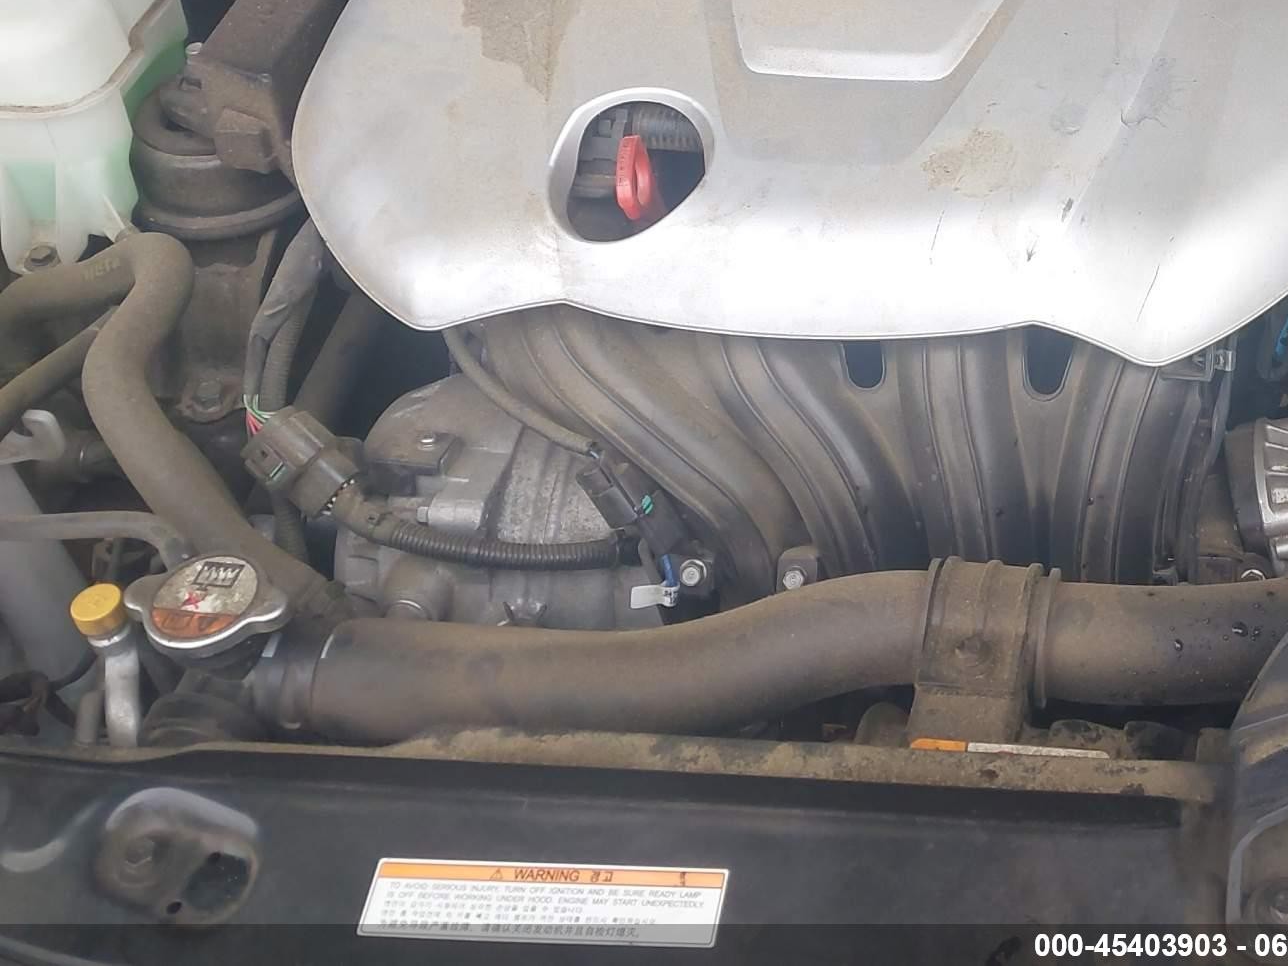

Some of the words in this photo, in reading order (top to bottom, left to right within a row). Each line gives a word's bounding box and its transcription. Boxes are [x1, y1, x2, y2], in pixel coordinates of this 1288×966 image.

[514, 869, 579, 882] WARNING
[404, 882, 428, 890] AVOID
[432, 883, 467, 891] SERIOUS
[648, 890, 676, 898] READY
[680, 891, 702, 899] LAMP
[418, 891, 450, 900] BEFORE
[455, 893, 492, 901] WORKING
[496, 894, 525, 902] UNDER
[558, 897, 587, 905] ENGINE
[613, 899, 638, 907] START
